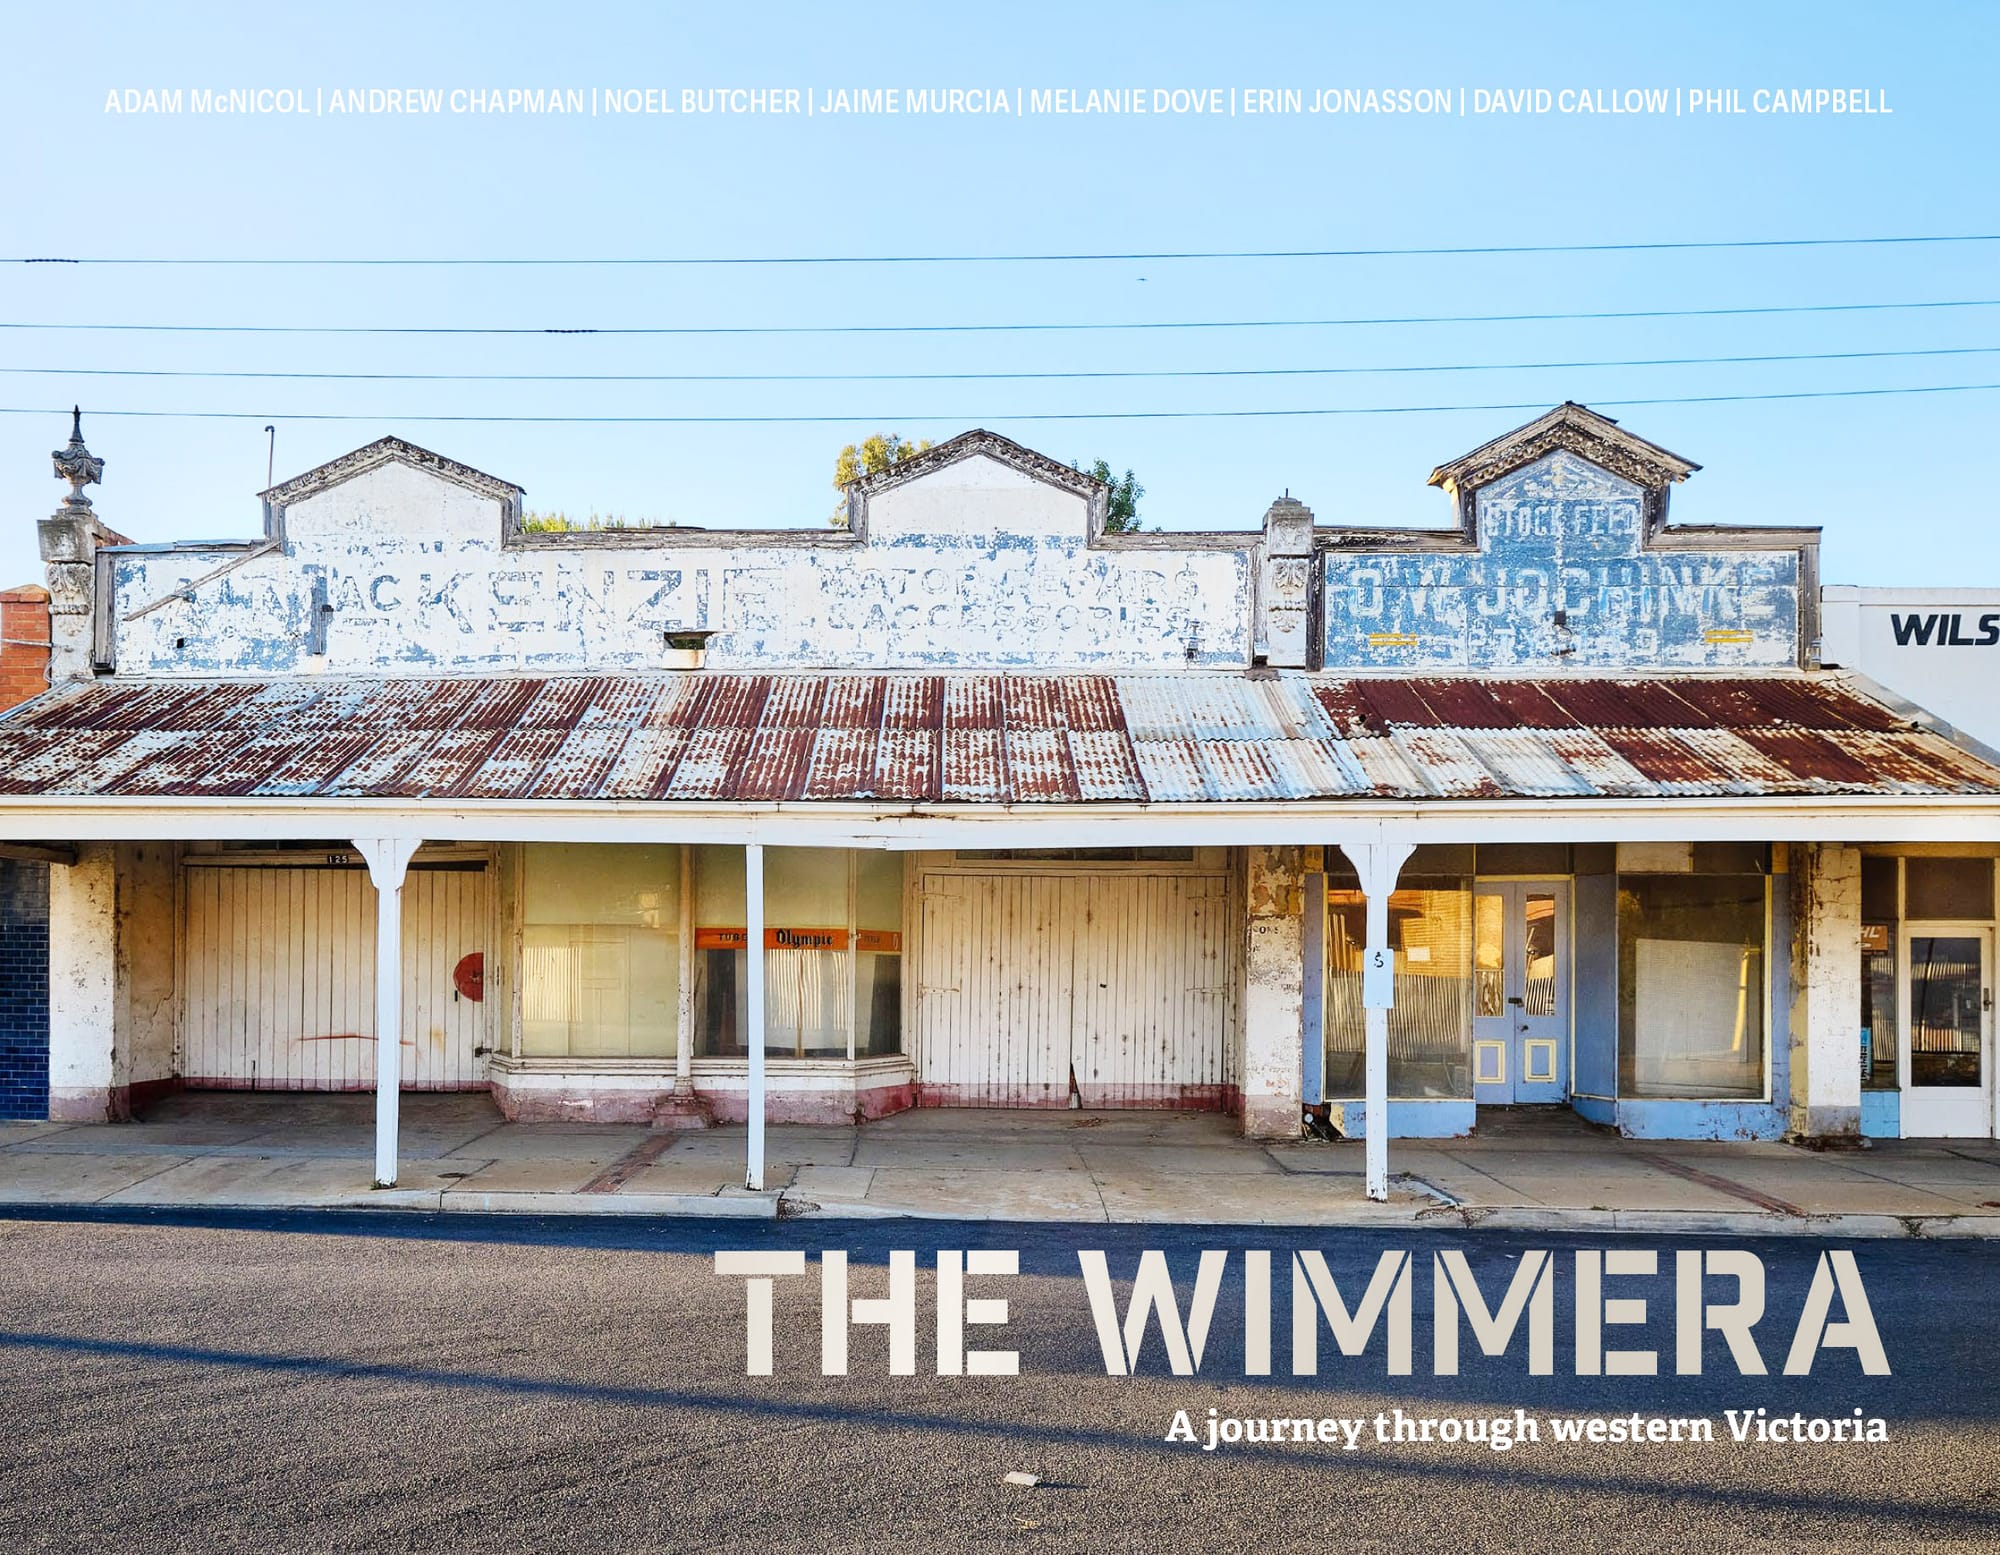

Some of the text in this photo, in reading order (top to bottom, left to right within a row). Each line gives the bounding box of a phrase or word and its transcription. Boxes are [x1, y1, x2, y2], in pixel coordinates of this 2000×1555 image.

[1485, 504, 1563, 537] STOCK
[1477, 565, 1777, 623] JOCHINKE
[863, 603, 1191, 632] ACCESSORIES
[1890, 613, 2000, 646] WILS
[328, 855, 348, 864] 125
[775, 928, 833, 948] Olympic
